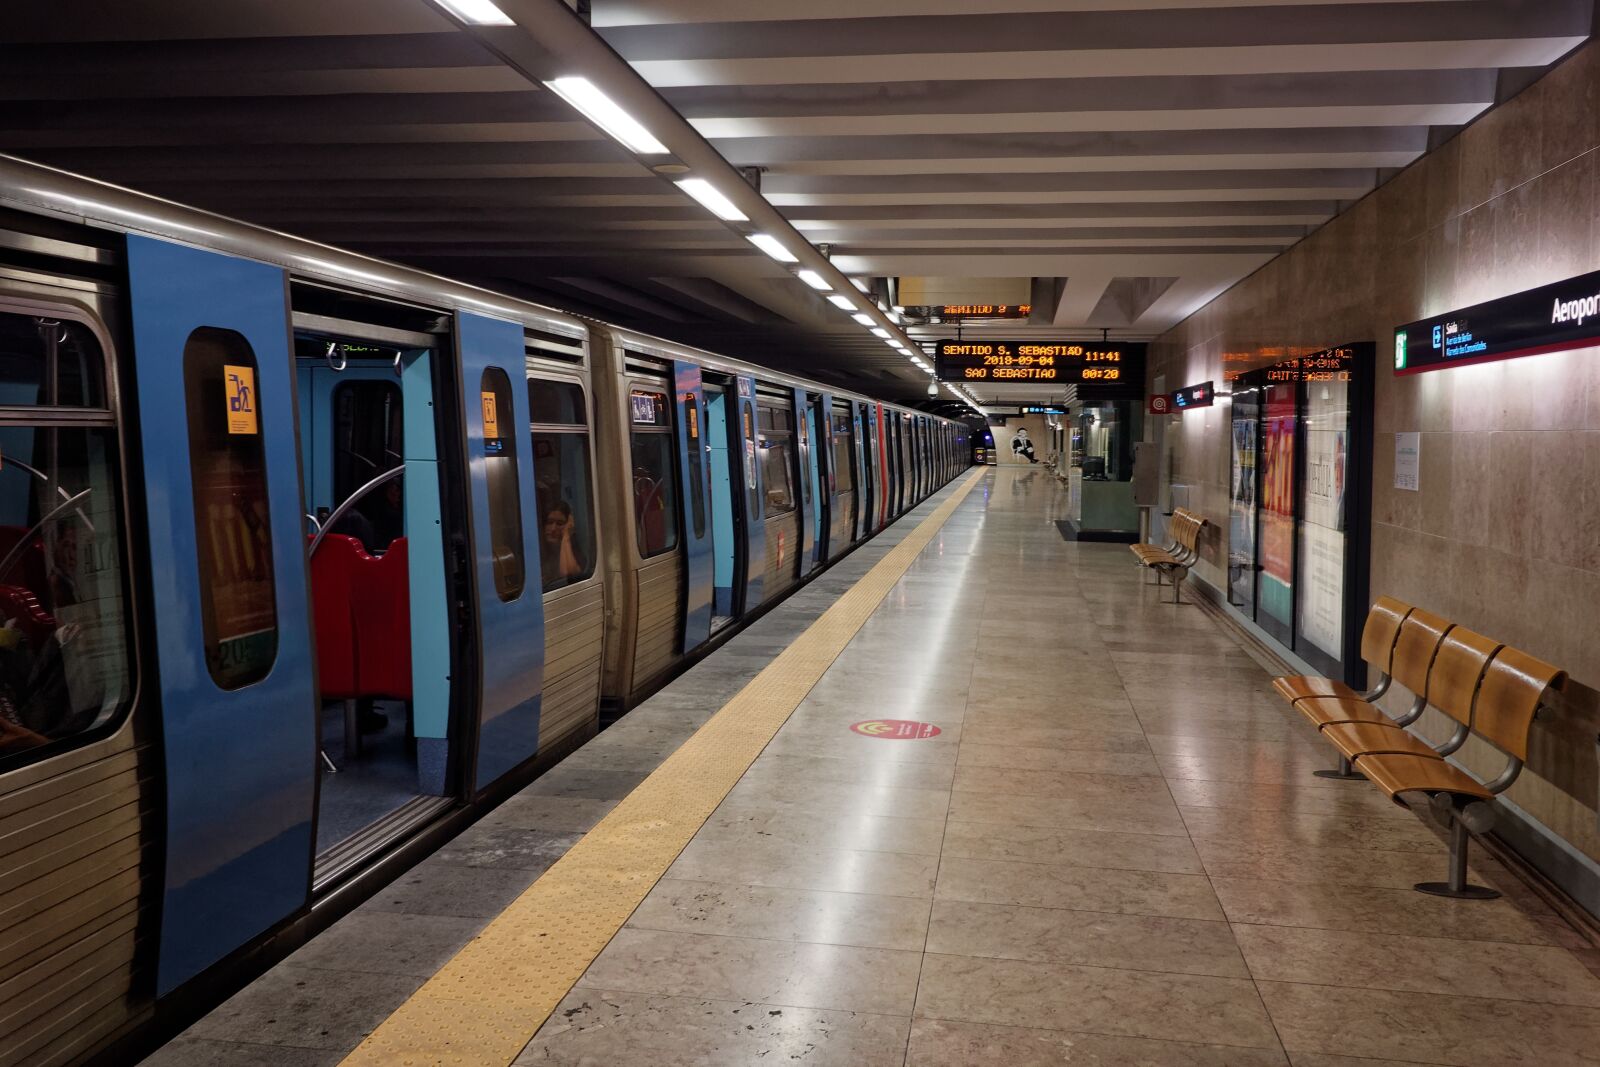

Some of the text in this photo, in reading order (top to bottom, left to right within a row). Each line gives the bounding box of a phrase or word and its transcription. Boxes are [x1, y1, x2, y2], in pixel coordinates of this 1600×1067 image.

[1551, 294, 1600, 326] Aeropor
[943, 346, 992, 355] SENTIDO
[998, 346, 1011, 356] S.
[1085, 352, 1121, 361] 11:41
[983, 355, 1055, 366] 2018-09-04
[965, 368, 1056, 379] SAO SEBASTIAO
[1082, 368, 1119, 379] 00:20
